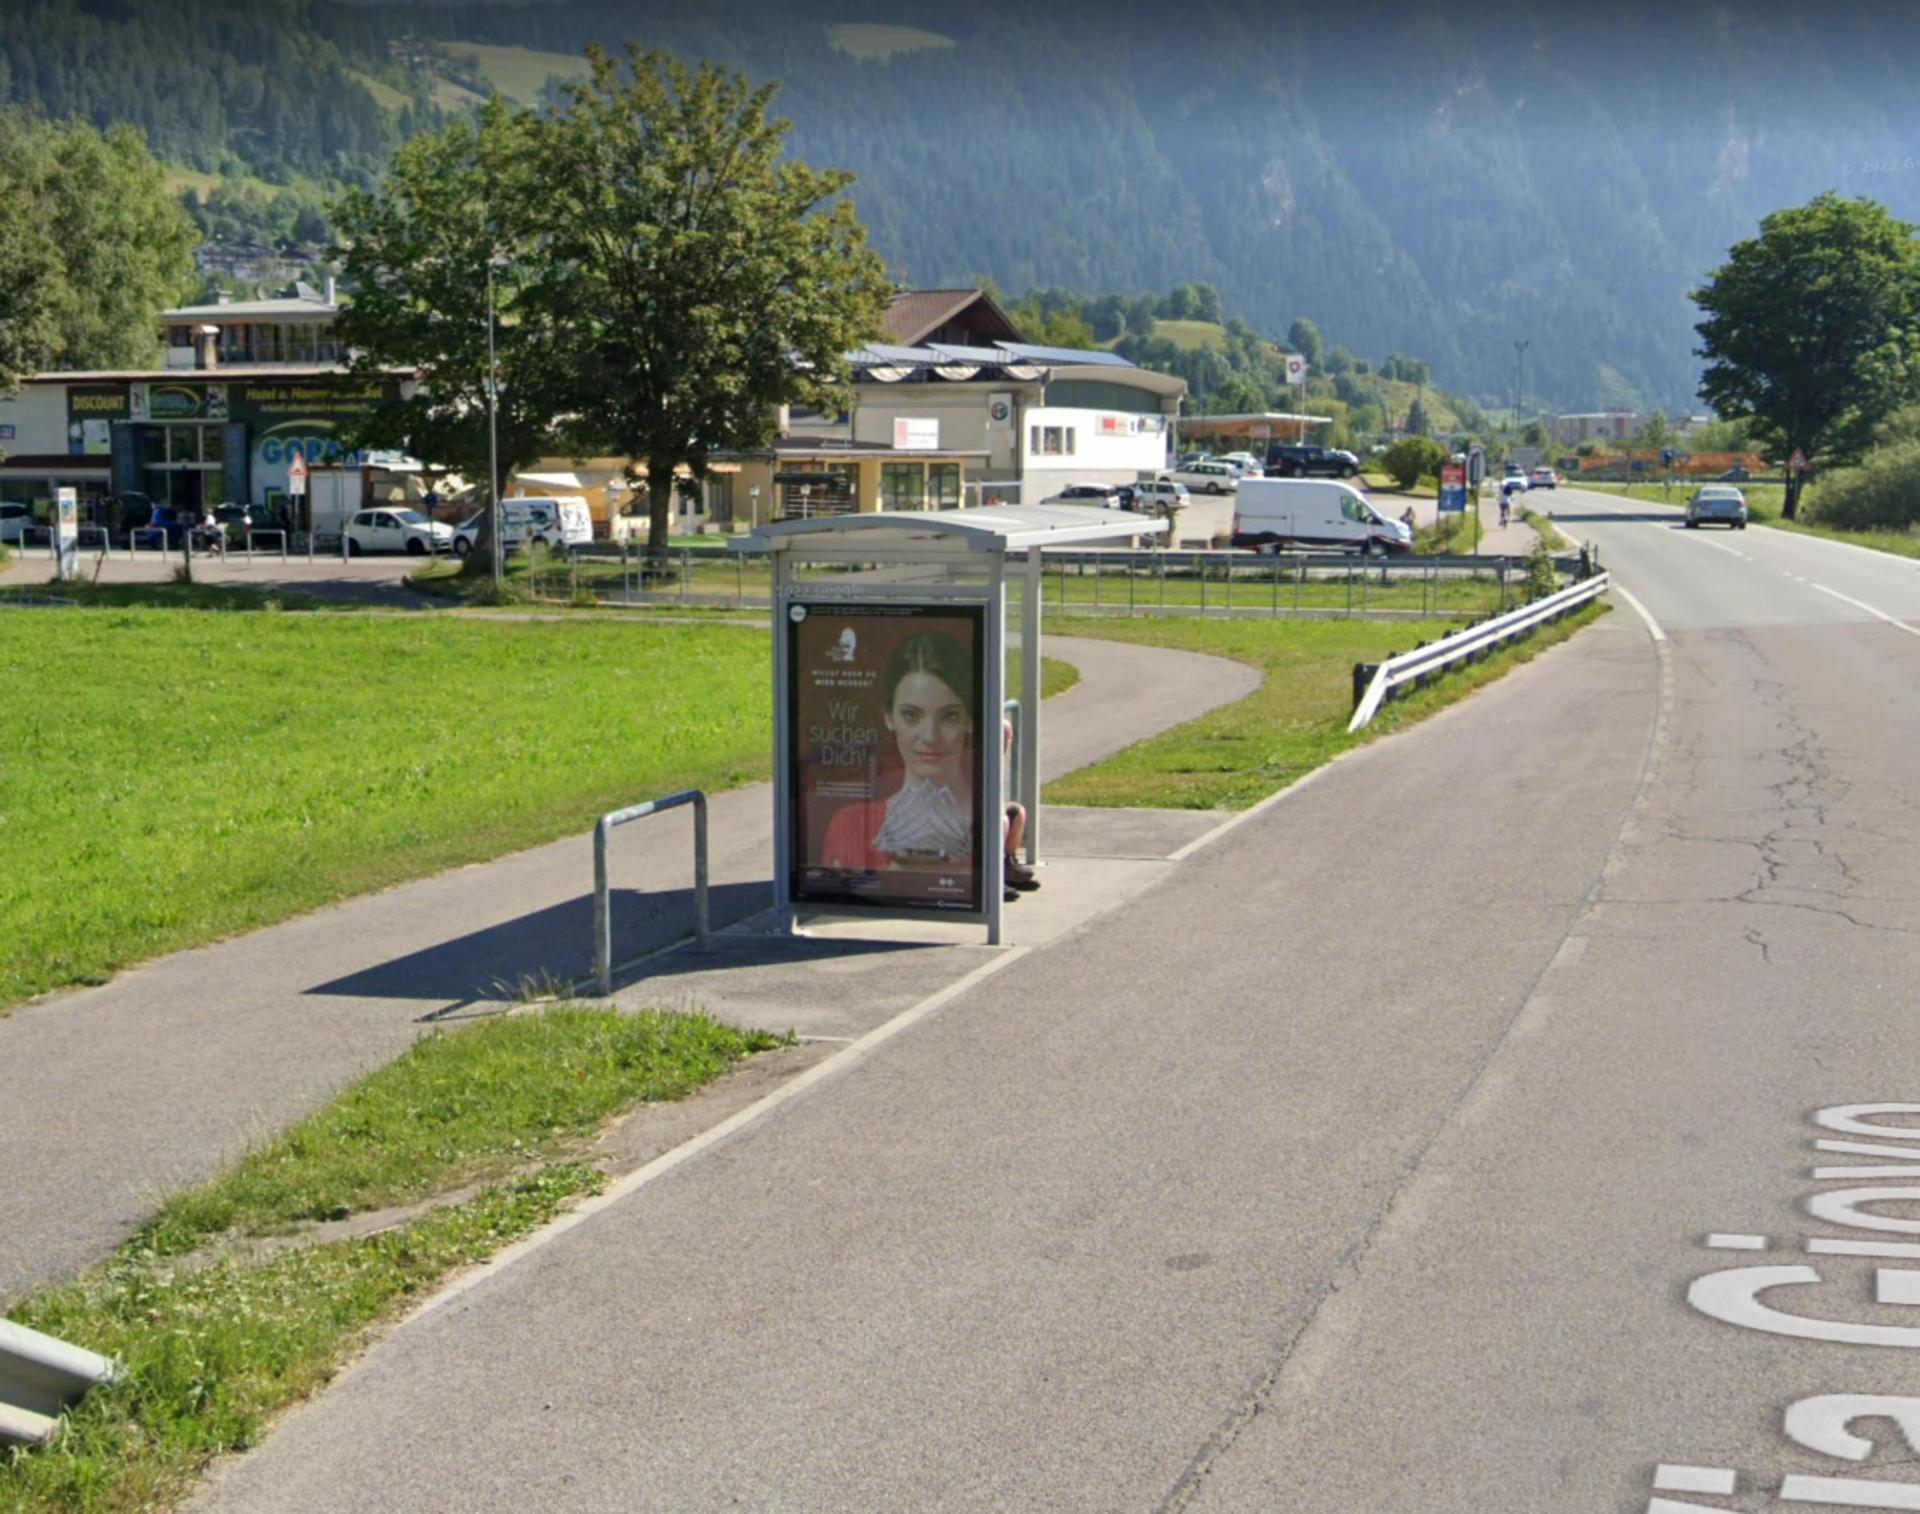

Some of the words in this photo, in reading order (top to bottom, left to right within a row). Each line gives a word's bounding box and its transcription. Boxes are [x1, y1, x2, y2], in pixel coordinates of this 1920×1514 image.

[72, 395, 125, 411] DISCOUNT
[827, 701, 860, 722] Wir
[809, 724, 878, 745] suchen
[822, 743, 866, 766] Dich!
